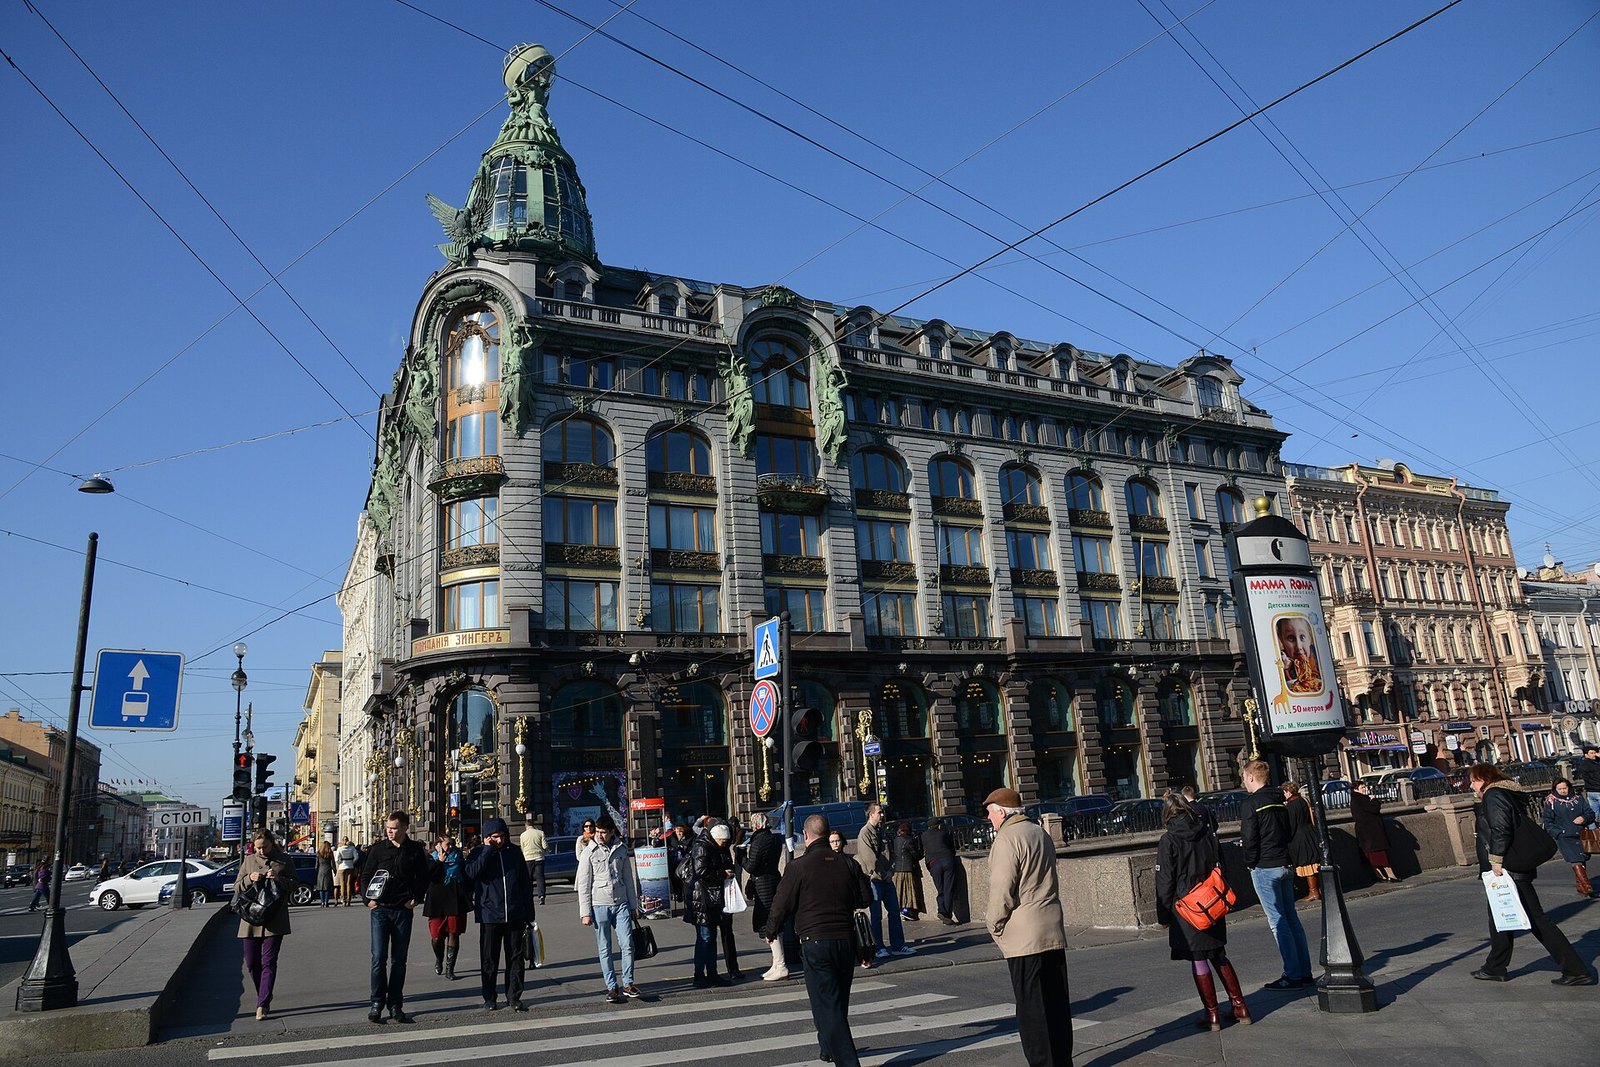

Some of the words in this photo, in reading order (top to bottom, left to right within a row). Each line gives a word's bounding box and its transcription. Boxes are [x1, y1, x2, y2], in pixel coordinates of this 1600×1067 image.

[1250, 579, 1287, 590] MAMA
[1289, 578, 1315, 591] ROMA
[456, 632, 503, 645] ЗИНГЕРЪ
[1292, 705, 1302, 714] 50
[1302, 705, 1324, 714] метров
[1565, 700, 1591, 714] КОФЕ
[161, 811, 202, 825] СТОП
